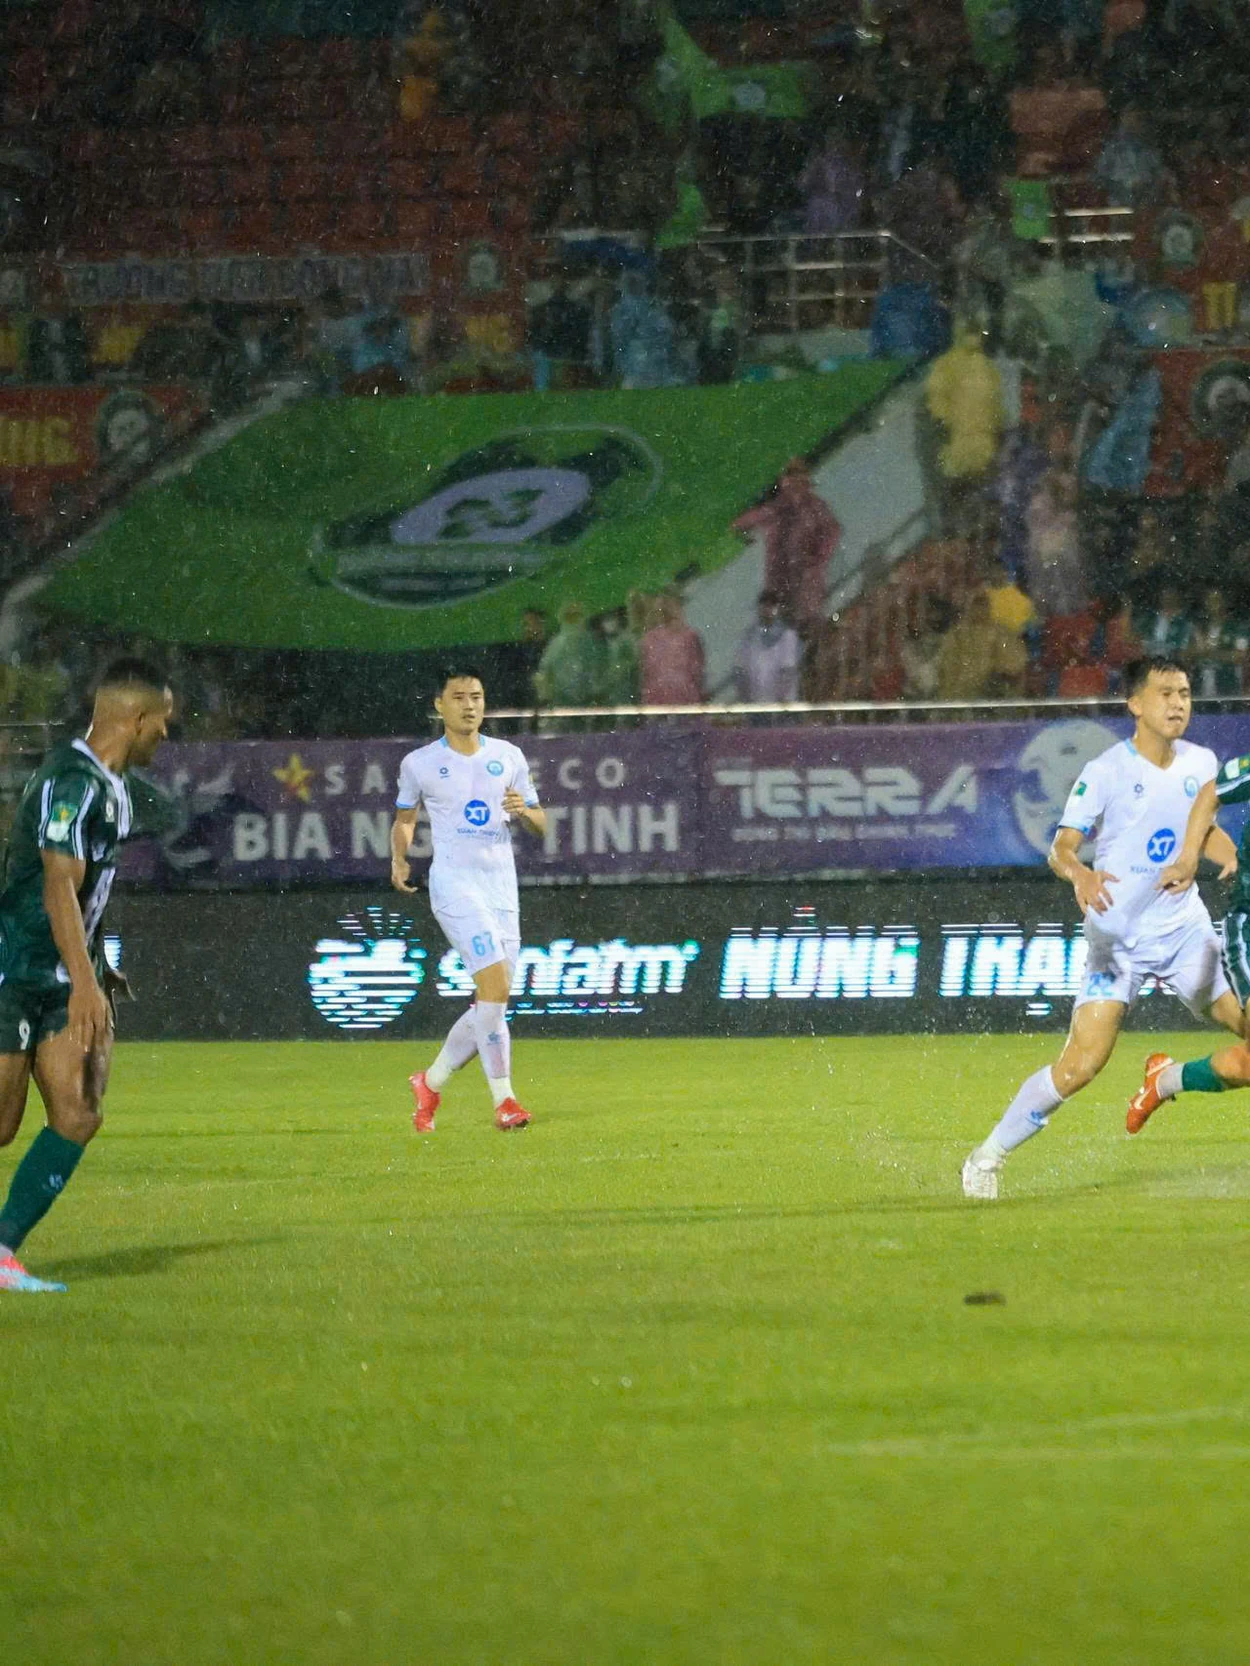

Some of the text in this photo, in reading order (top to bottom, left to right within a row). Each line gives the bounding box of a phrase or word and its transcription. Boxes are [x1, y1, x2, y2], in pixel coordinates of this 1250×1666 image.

[713, 764, 978, 818] TERRA
[233, 811, 333, 861] BIA
[472, 931, 496, 956] 67
